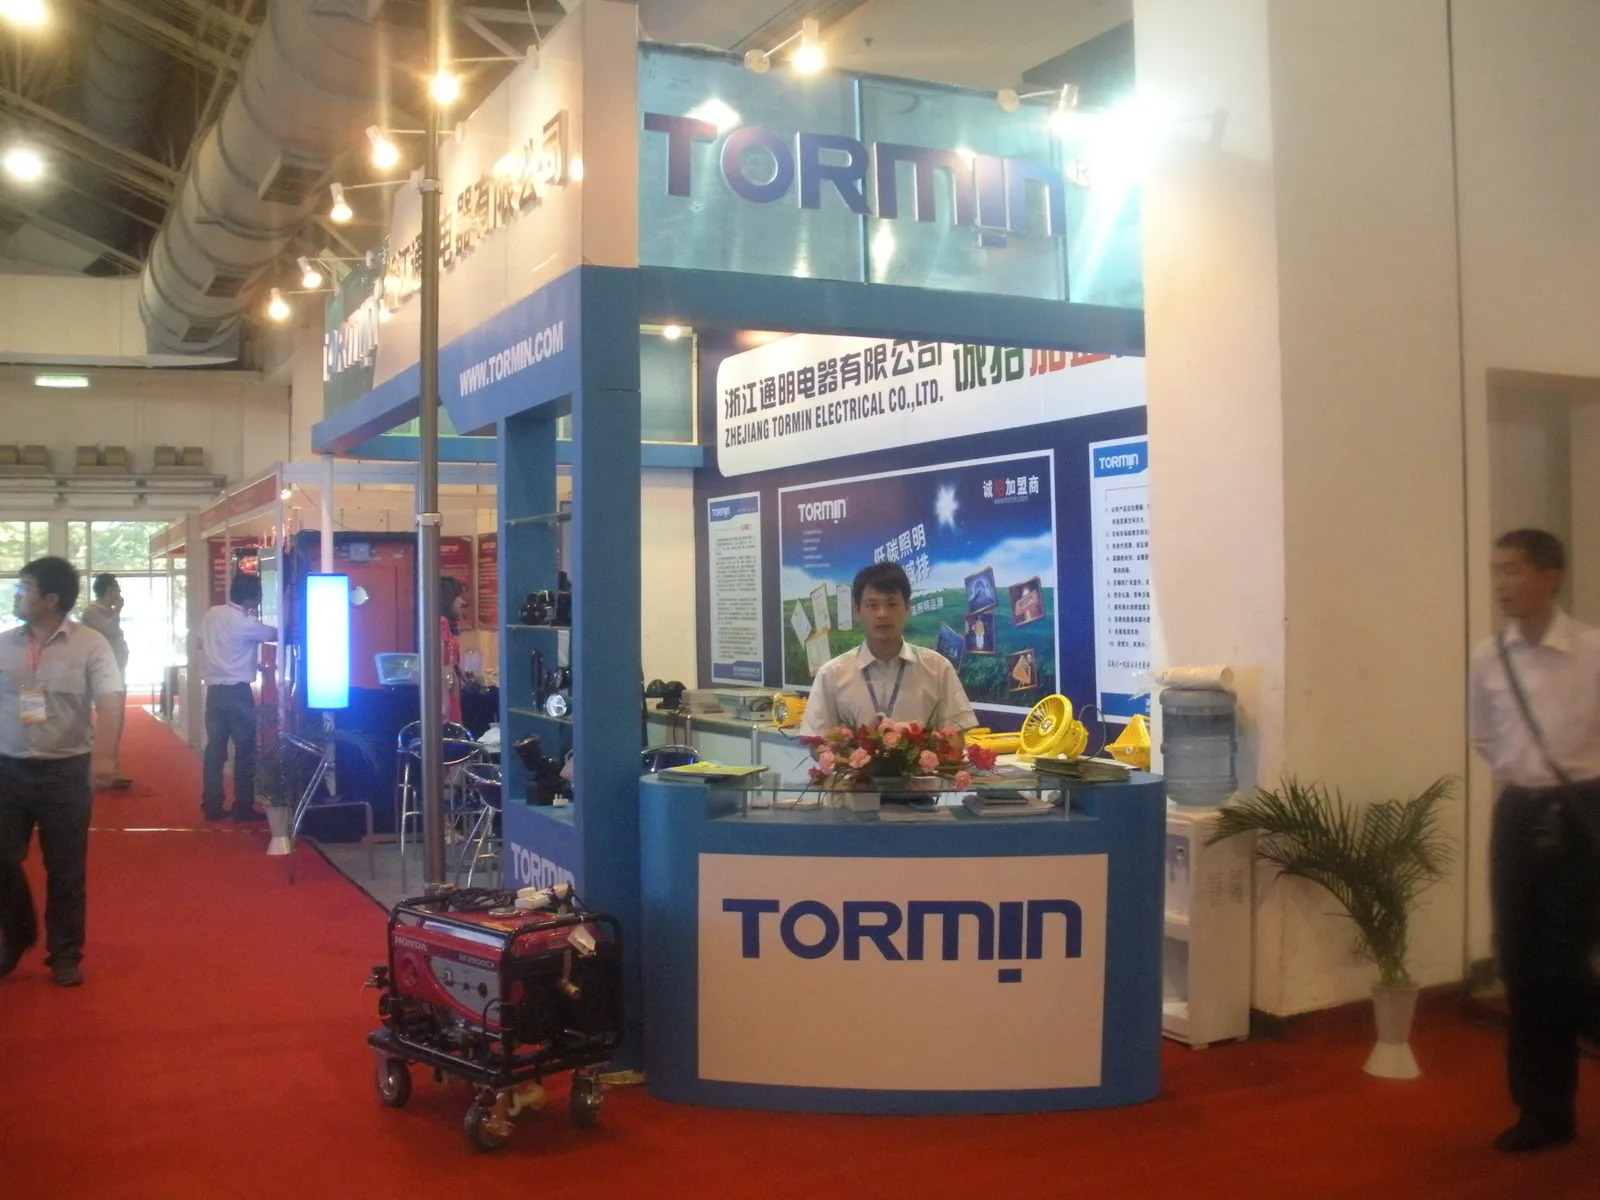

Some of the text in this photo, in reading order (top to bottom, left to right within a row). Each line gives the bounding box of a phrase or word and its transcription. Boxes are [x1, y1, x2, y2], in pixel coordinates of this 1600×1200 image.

[460, 320, 564, 397] WWW.TORMIN.COM
[725, 341, 942, 420] 浙江通明电器有限公司
[725, 418, 770, 448] ZHEJIANG
[772, 408, 812, 438] TORMIN
[815, 391, 885, 428] ELECTRICAL
[874, 523, 927, 565] 低碳照明
